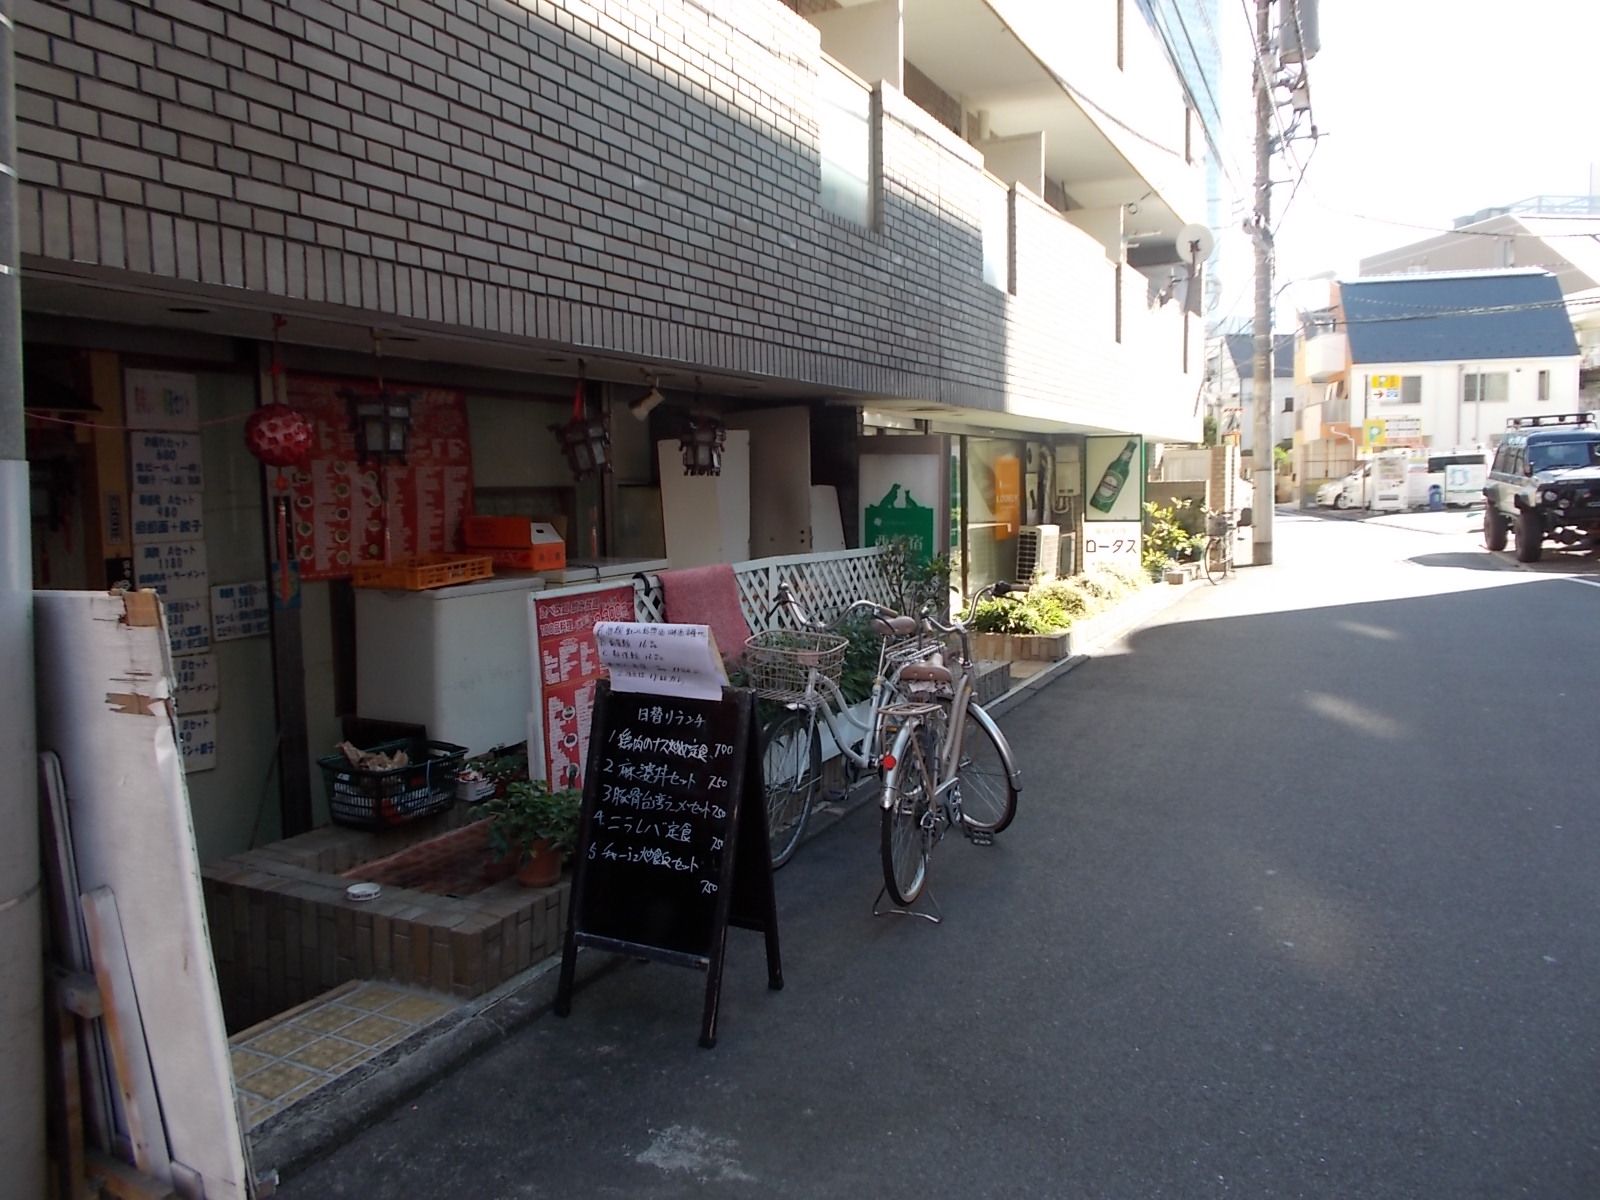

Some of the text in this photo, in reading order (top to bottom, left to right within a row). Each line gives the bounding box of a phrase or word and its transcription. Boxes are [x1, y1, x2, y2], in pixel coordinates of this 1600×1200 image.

[1085, 539, 1137, 554] ロータス
[637, 706, 705, 728] 日替りランチ
[714, 743, 734, 758] 700
[603, 758, 614, 773] 2
[707, 775, 728, 790] 750
[602, 784, 612, 802] 3
[711, 805, 727, 820] 750
[588, 842, 598, 860] 5
[700, 880, 719, 895] 750
